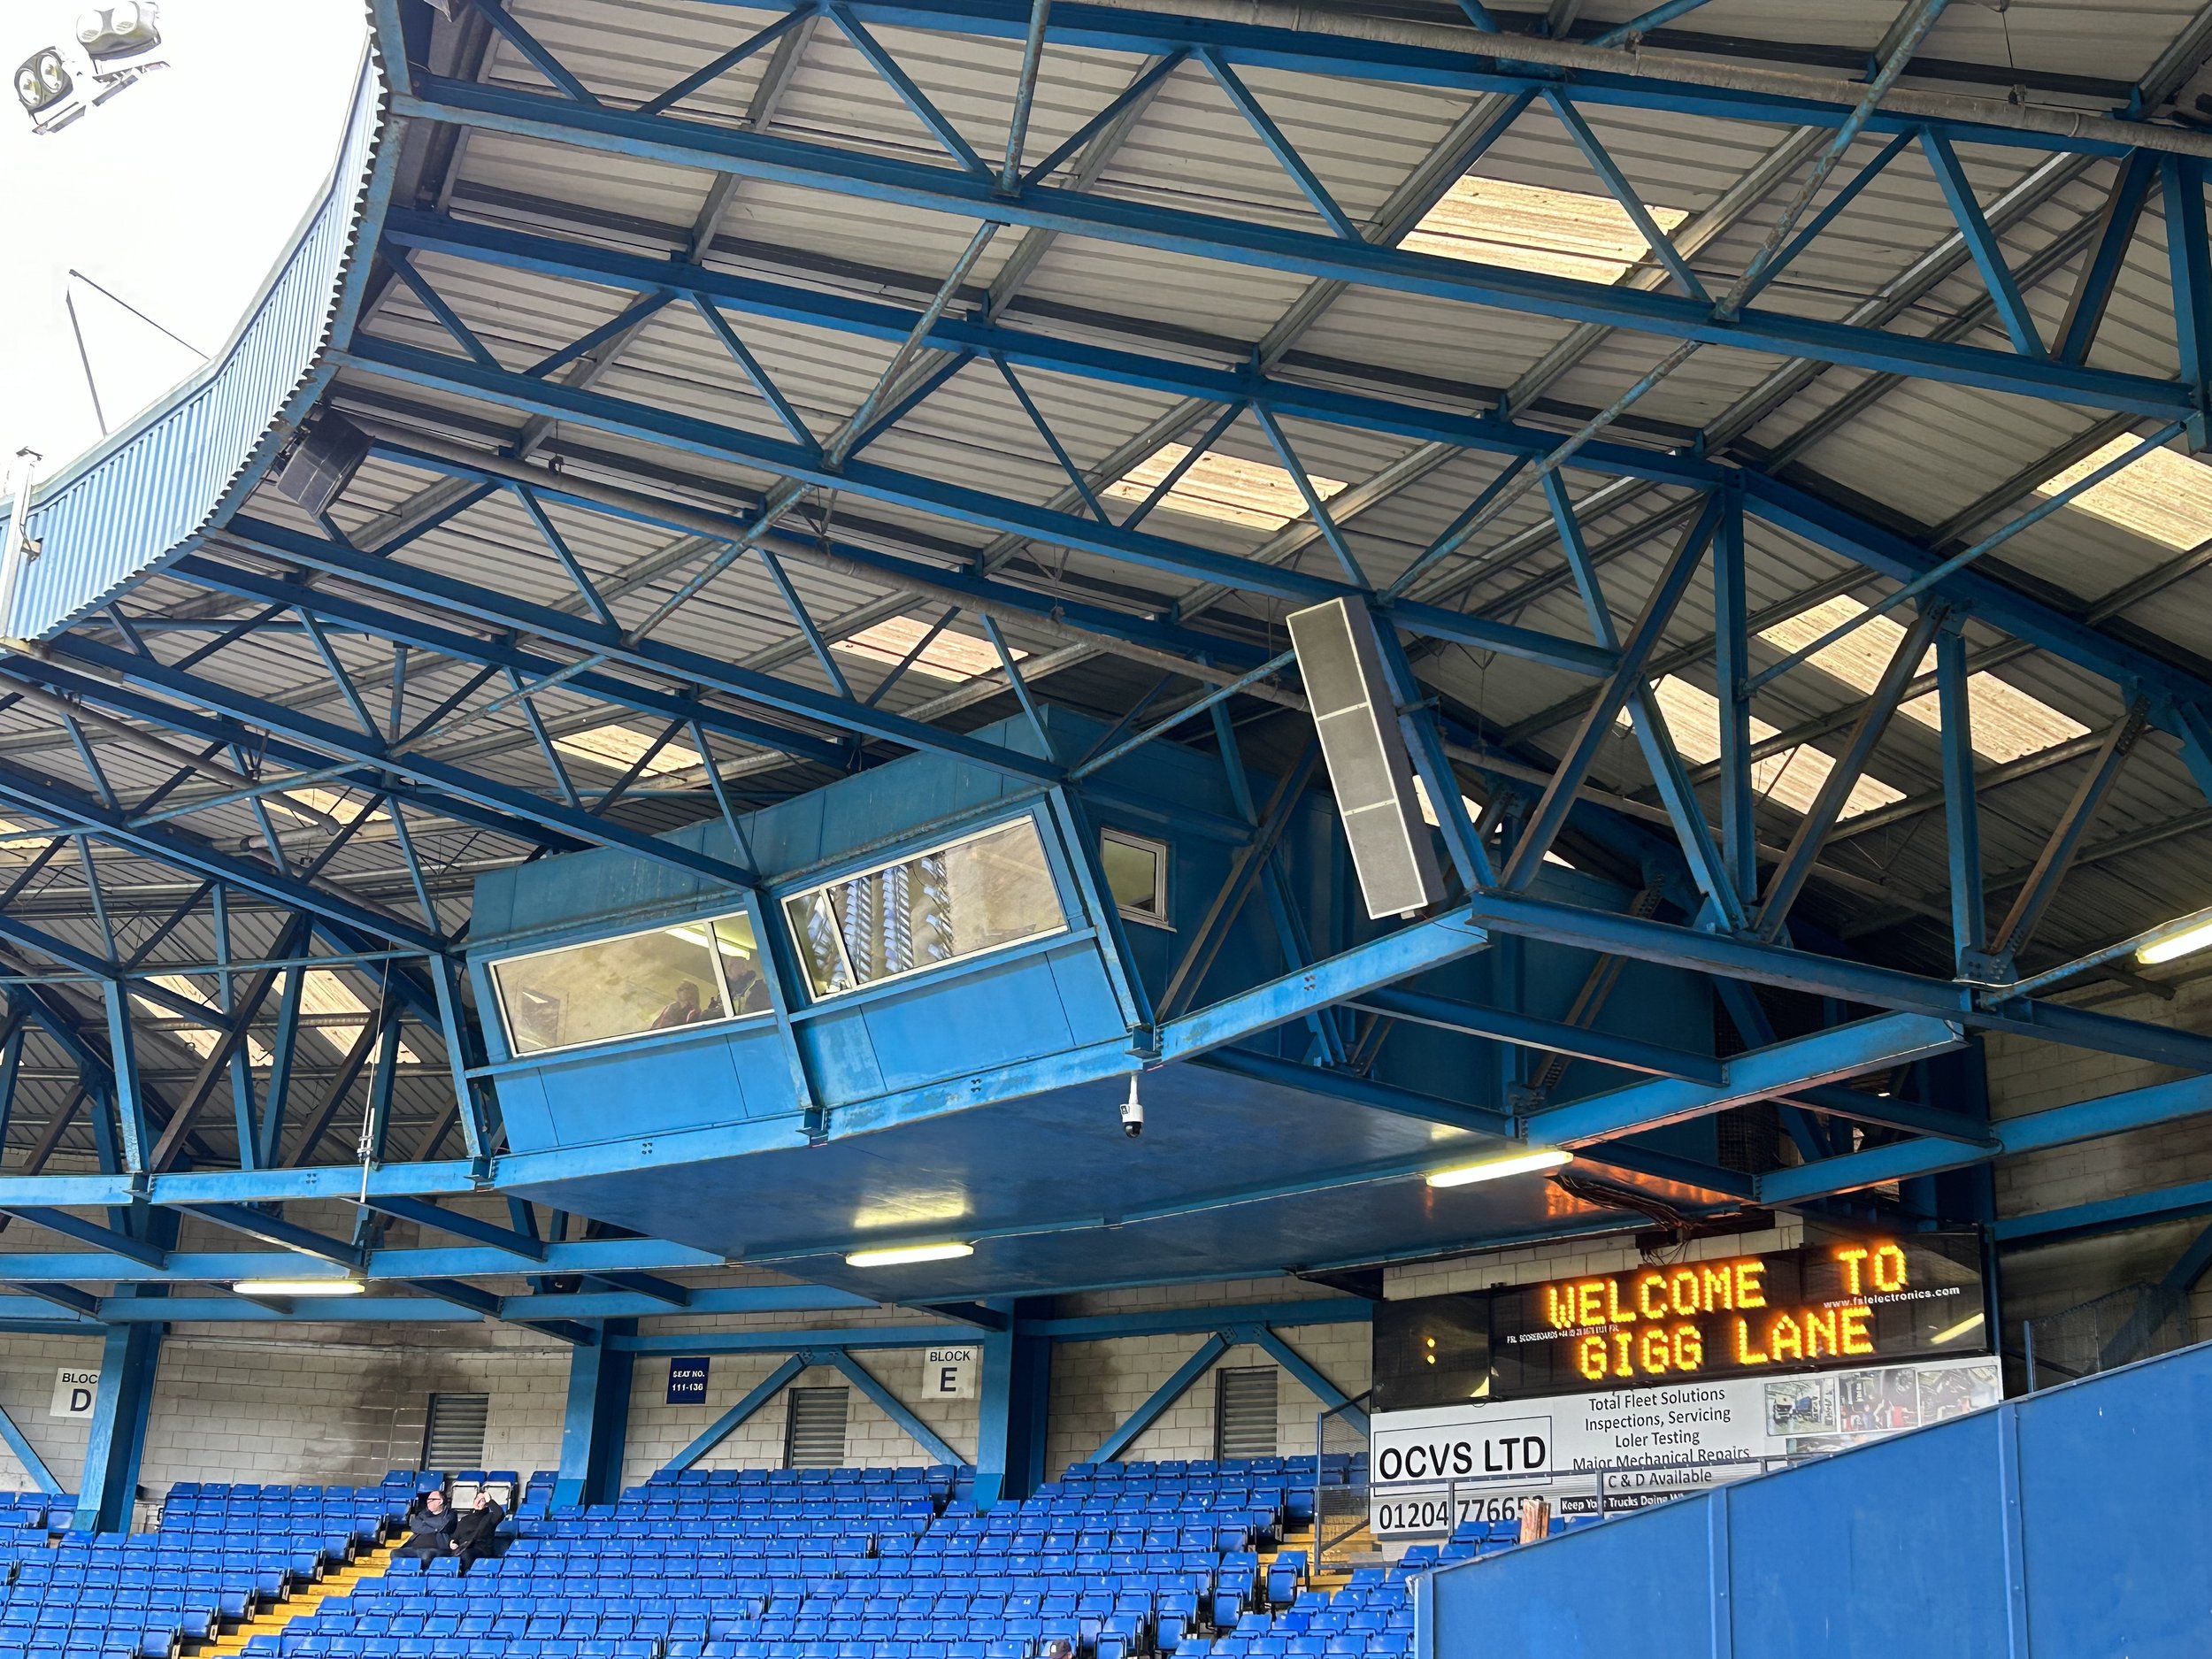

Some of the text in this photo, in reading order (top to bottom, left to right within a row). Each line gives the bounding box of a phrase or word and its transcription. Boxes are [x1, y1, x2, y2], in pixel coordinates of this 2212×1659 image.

[1549, 1244, 1908, 1329] WELCOME TO
[1823, 1286, 1961, 1309] www.fslelectronics.com
[1580, 1305, 1874, 1380] GIGG LANE
[930, 1350, 971, 1362] BLOCK
[62, 1372, 99, 1384] BLOC
[941, 1367, 957, 1392] E
[70, 1388, 92, 1412] D
[1588, 1387, 1725, 1411] Total Fleet Solutions
[1585, 1407, 1732, 1432] Inspections, Servicing
[1615, 1429, 1701, 1448] Loler Testing
[1379, 1436, 1547, 1479] OCVS LTD
[1572, 1446, 1750, 1471] Major Mechanical Repairs
[1608, 1468, 1713, 1488] C & D Available
[1379, 1495, 1545, 1530] 01204 7766
[1562, 1500, 1585, 1511] Keep
[1586, 1498, 1607, 1509] Yor
[1609, 1496, 1638, 1508] Trucks
